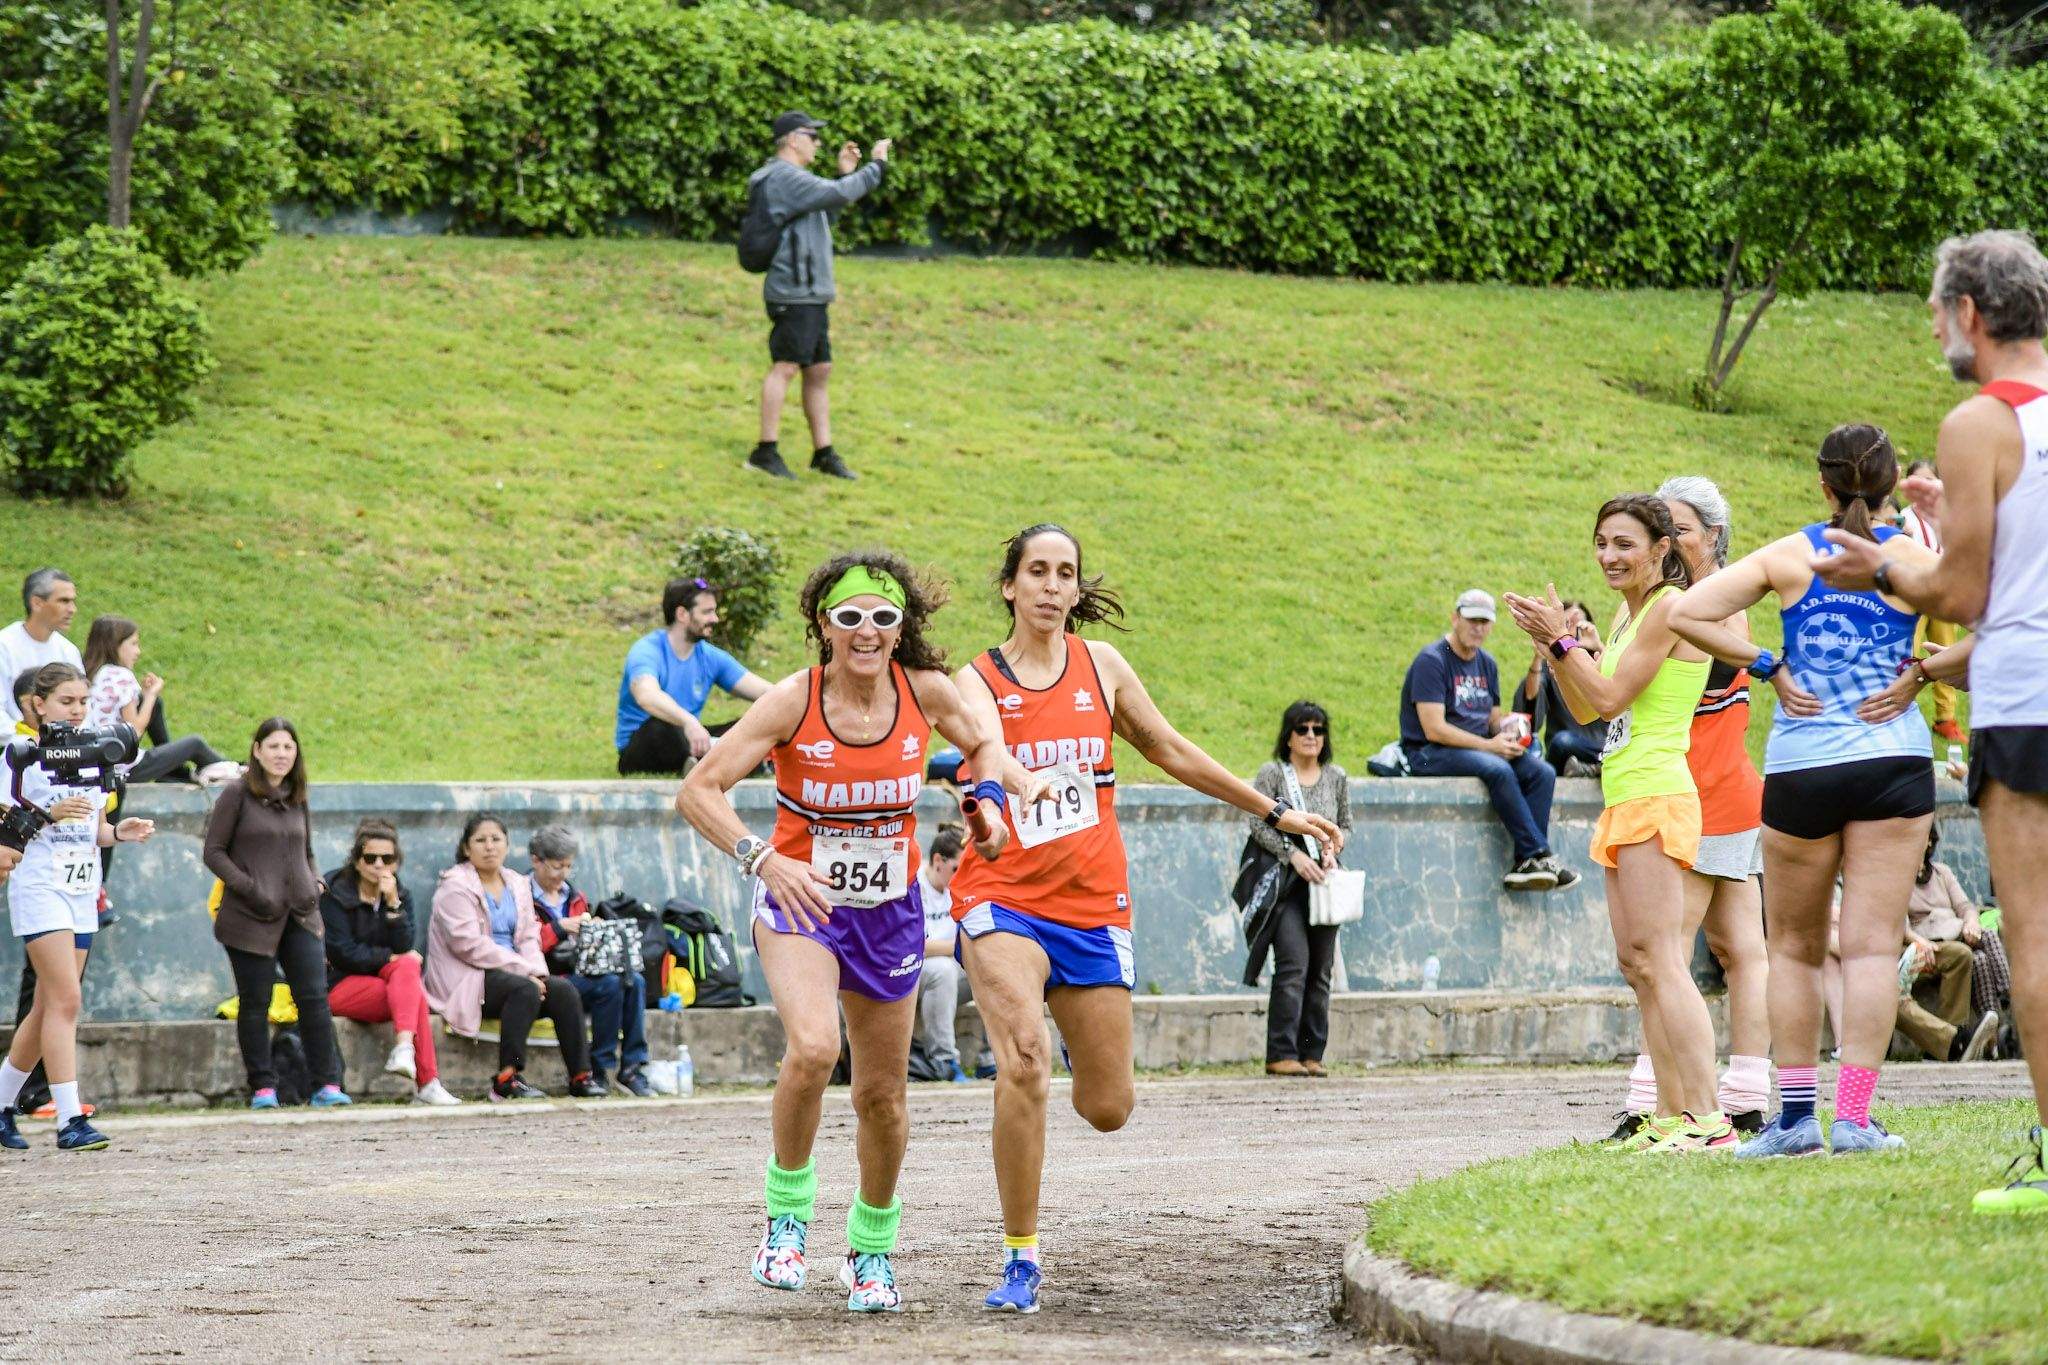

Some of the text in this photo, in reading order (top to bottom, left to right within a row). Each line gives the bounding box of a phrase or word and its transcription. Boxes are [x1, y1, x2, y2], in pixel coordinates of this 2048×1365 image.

[1800, 593, 1886, 616] A.D. SPORTING
[1832, 613, 1847, 621] DE
[46, 749, 81, 759] RONIN
[1006, 736, 1105, 769] ADRID
[801, 772, 921, 807] MADRID
[877, 820, 904, 837] RUN
[64, 862, 94, 884] 747
[829, 861, 890, 893] 854
